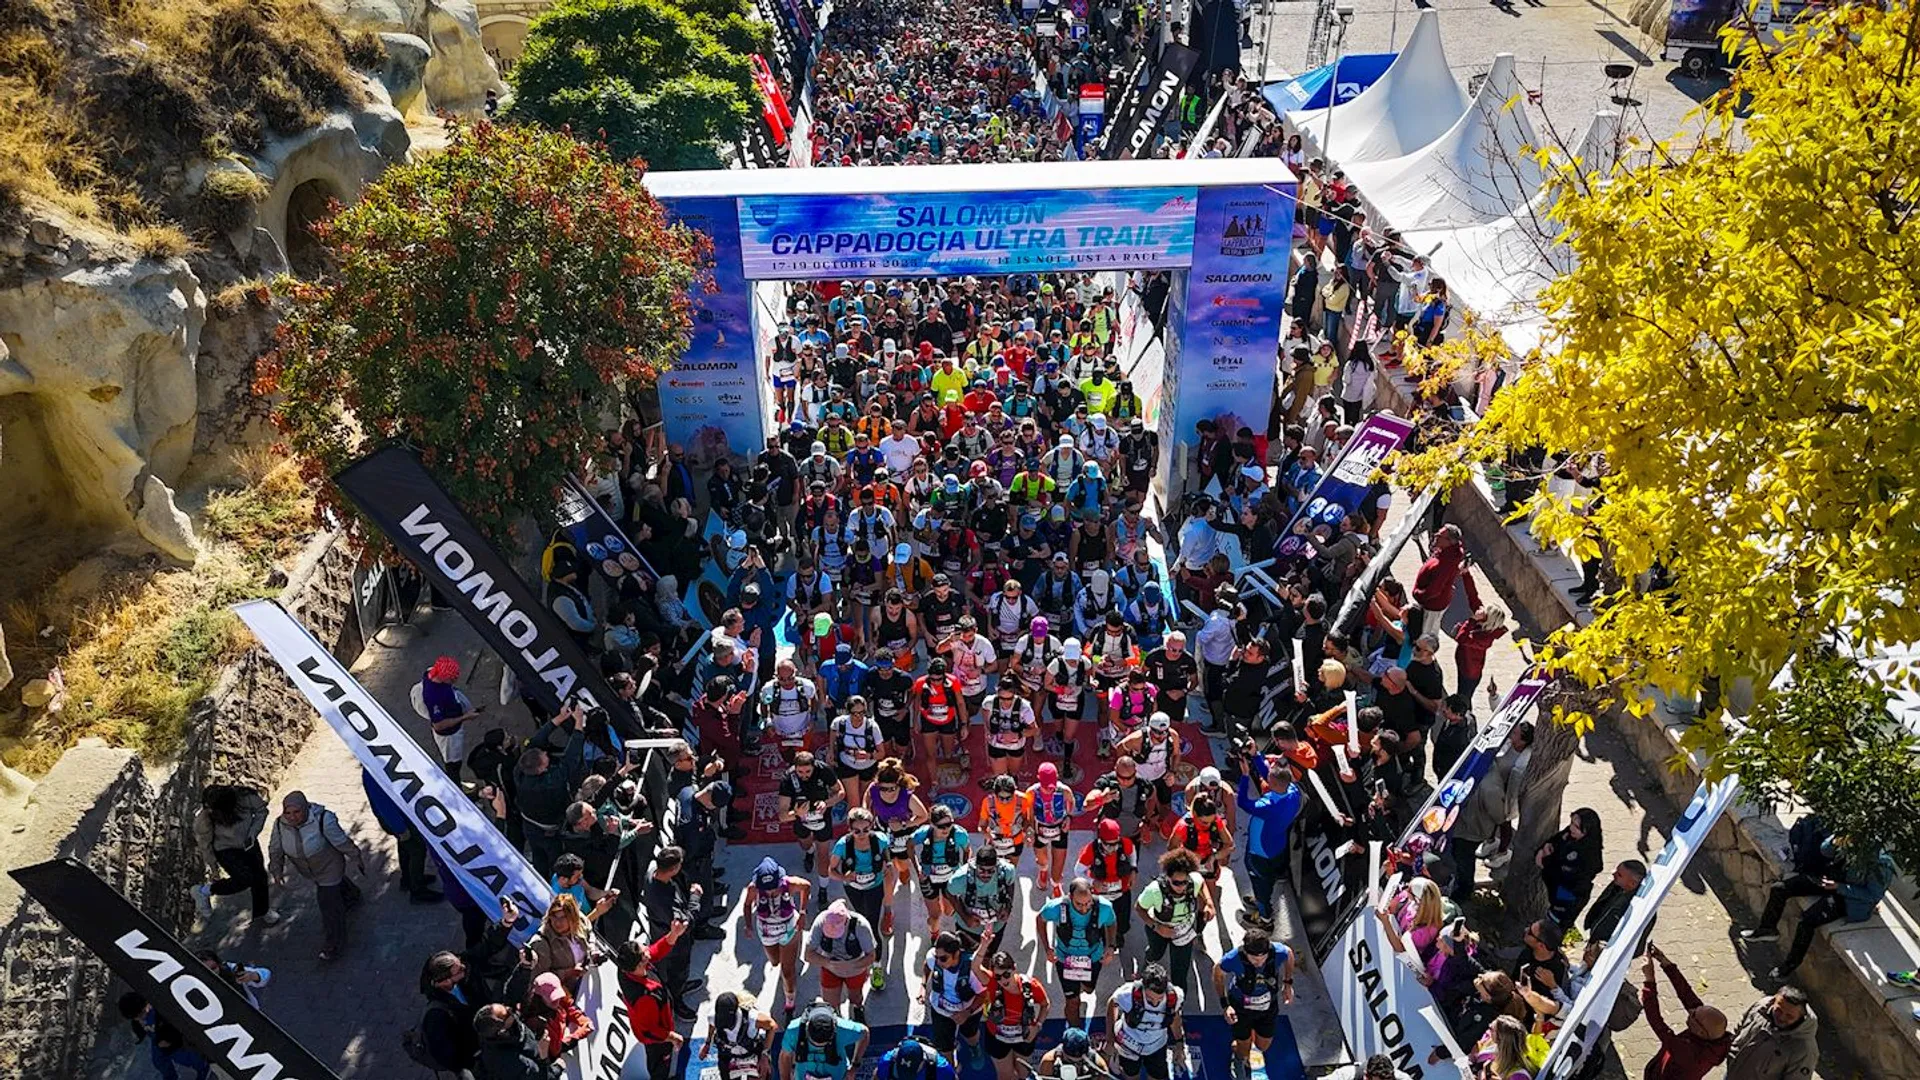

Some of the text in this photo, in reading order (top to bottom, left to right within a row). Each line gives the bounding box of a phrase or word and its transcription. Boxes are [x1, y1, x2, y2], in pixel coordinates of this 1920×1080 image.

[1131, 70, 1180, 157] OMON
[896, 203, 1047, 229] SALOMON
[771, 225, 1160, 255] CAPPADOCIA ULTRA TRAIL
[998, 252, 1159, 265] IT IS NOT JUST A RACE
[772, 261, 807, 271] 17-19
[813, 260, 877, 270] OCTOBER
[1204, 273, 1272, 283] SALOMON
[673, 362, 738, 372] SALOMON
